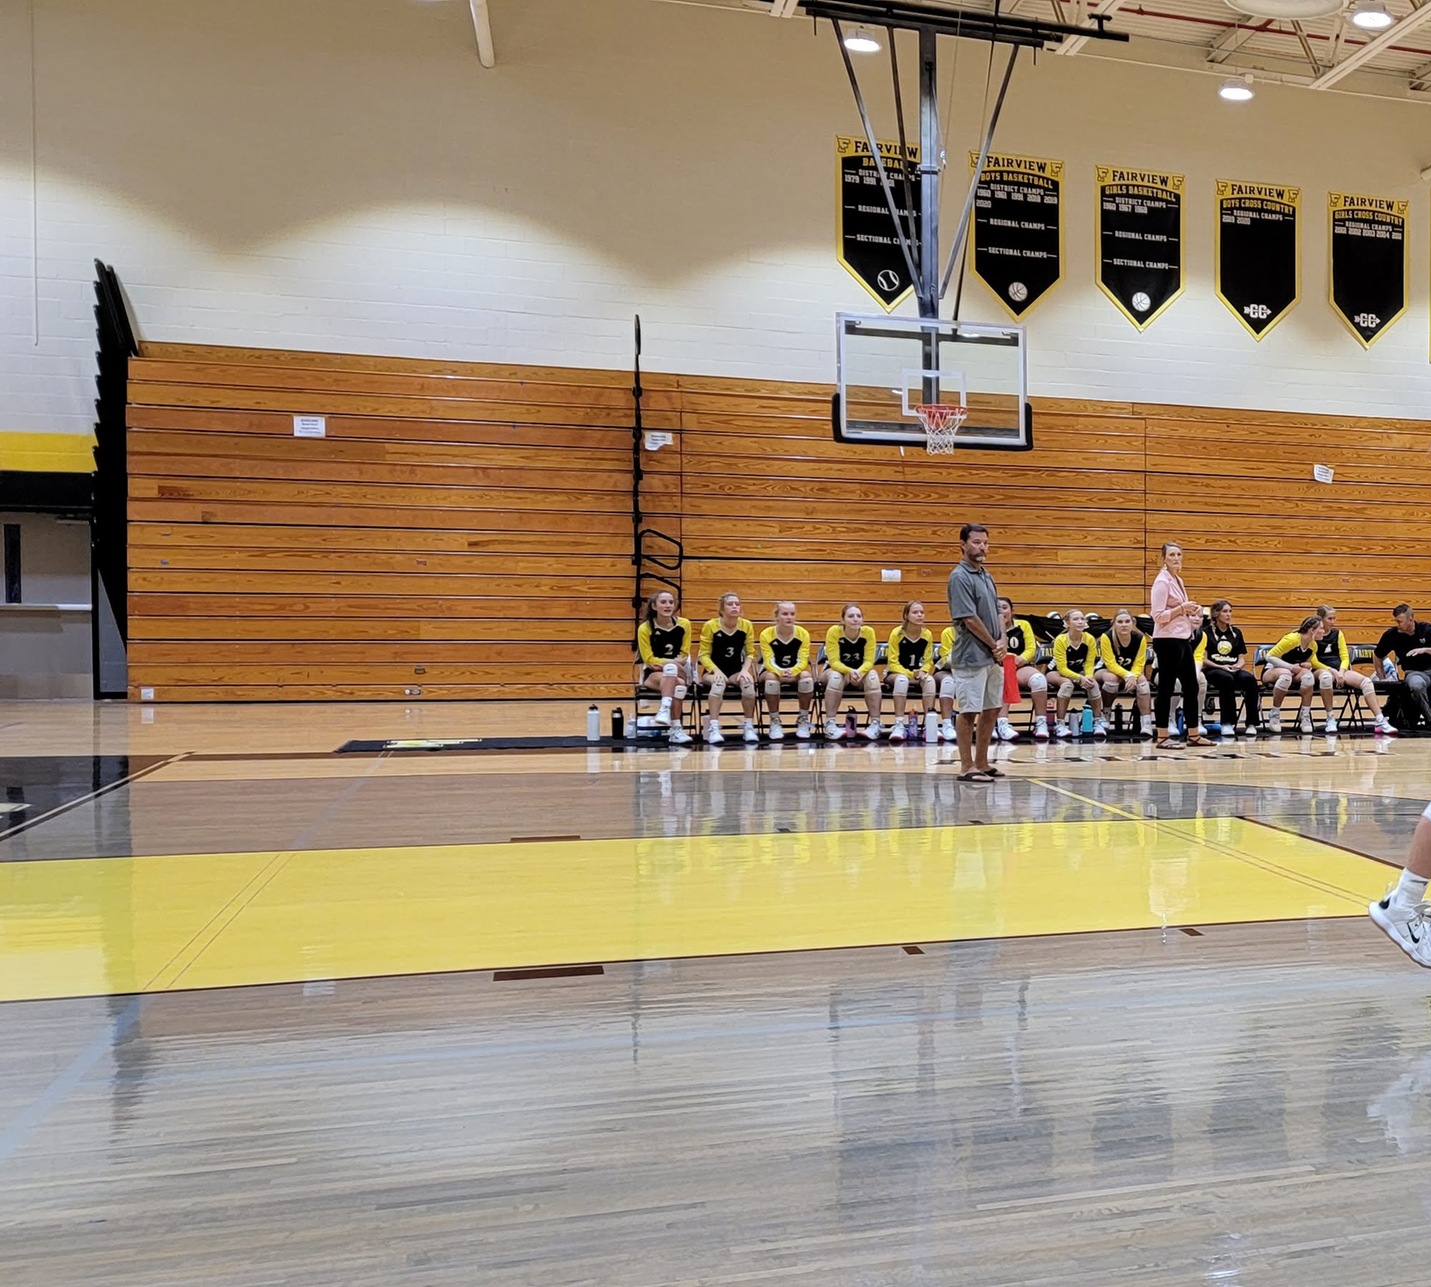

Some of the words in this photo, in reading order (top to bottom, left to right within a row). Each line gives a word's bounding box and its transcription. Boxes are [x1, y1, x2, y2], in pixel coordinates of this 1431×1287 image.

[986, 156, 1046, 173] FAIRVIEW
[981, 172, 1000, 181] BOYS
[1003, 172, 1053, 189] BASKETBALL
[1112, 170, 1169, 187] FAIRVIEW
[990, 183, 1018, 193] DISTRICT
[1020, 186, 1044, 195] CHAMPS
[1105, 186, 1126, 194] GIRLS
[1128, 186, 1175, 202] BASKETBALL
[1231, 184, 1285, 200] FAIRVIEW
[1115, 197, 1141, 206] DISTRICT
[1143, 200, 1166, 208] CHAMPS
[1223, 199, 1239, 208] BOYS
[1241, 199, 1261, 208] CROSS
[1263, 201, 1293, 215] COUNTRY
[1343, 196, 1394, 211] FAIRVIEW
[858, 205, 889, 214] REGIONAL
[1261, 212, 1283, 221] CHAMPS
[1335, 211, 1352, 219] GIRLS
[1354, 211, 1373, 219] CROSS
[1374, 212, 1402, 225] COUNTRY
[990, 218, 1019, 228] REGIONAL
[1021, 221, 1045, 230] CHAMPS
[856, 234, 891, 244] SECTIONAL
[1115, 230, 1142, 240] REGIONAL
[1144, 233, 1167, 242] CHAMPS
[988, 247, 1021, 257] SECTIONAL
[1022, 250, 1047, 258] CHAMPS
[1113, 258, 1144, 268] SECTIONAL
[1145, 261, 1168, 270] CHAMPS
[664, 643, 674, 655] 2
[725, 647, 734, 658] 3
[782, 655, 792, 666] 5
